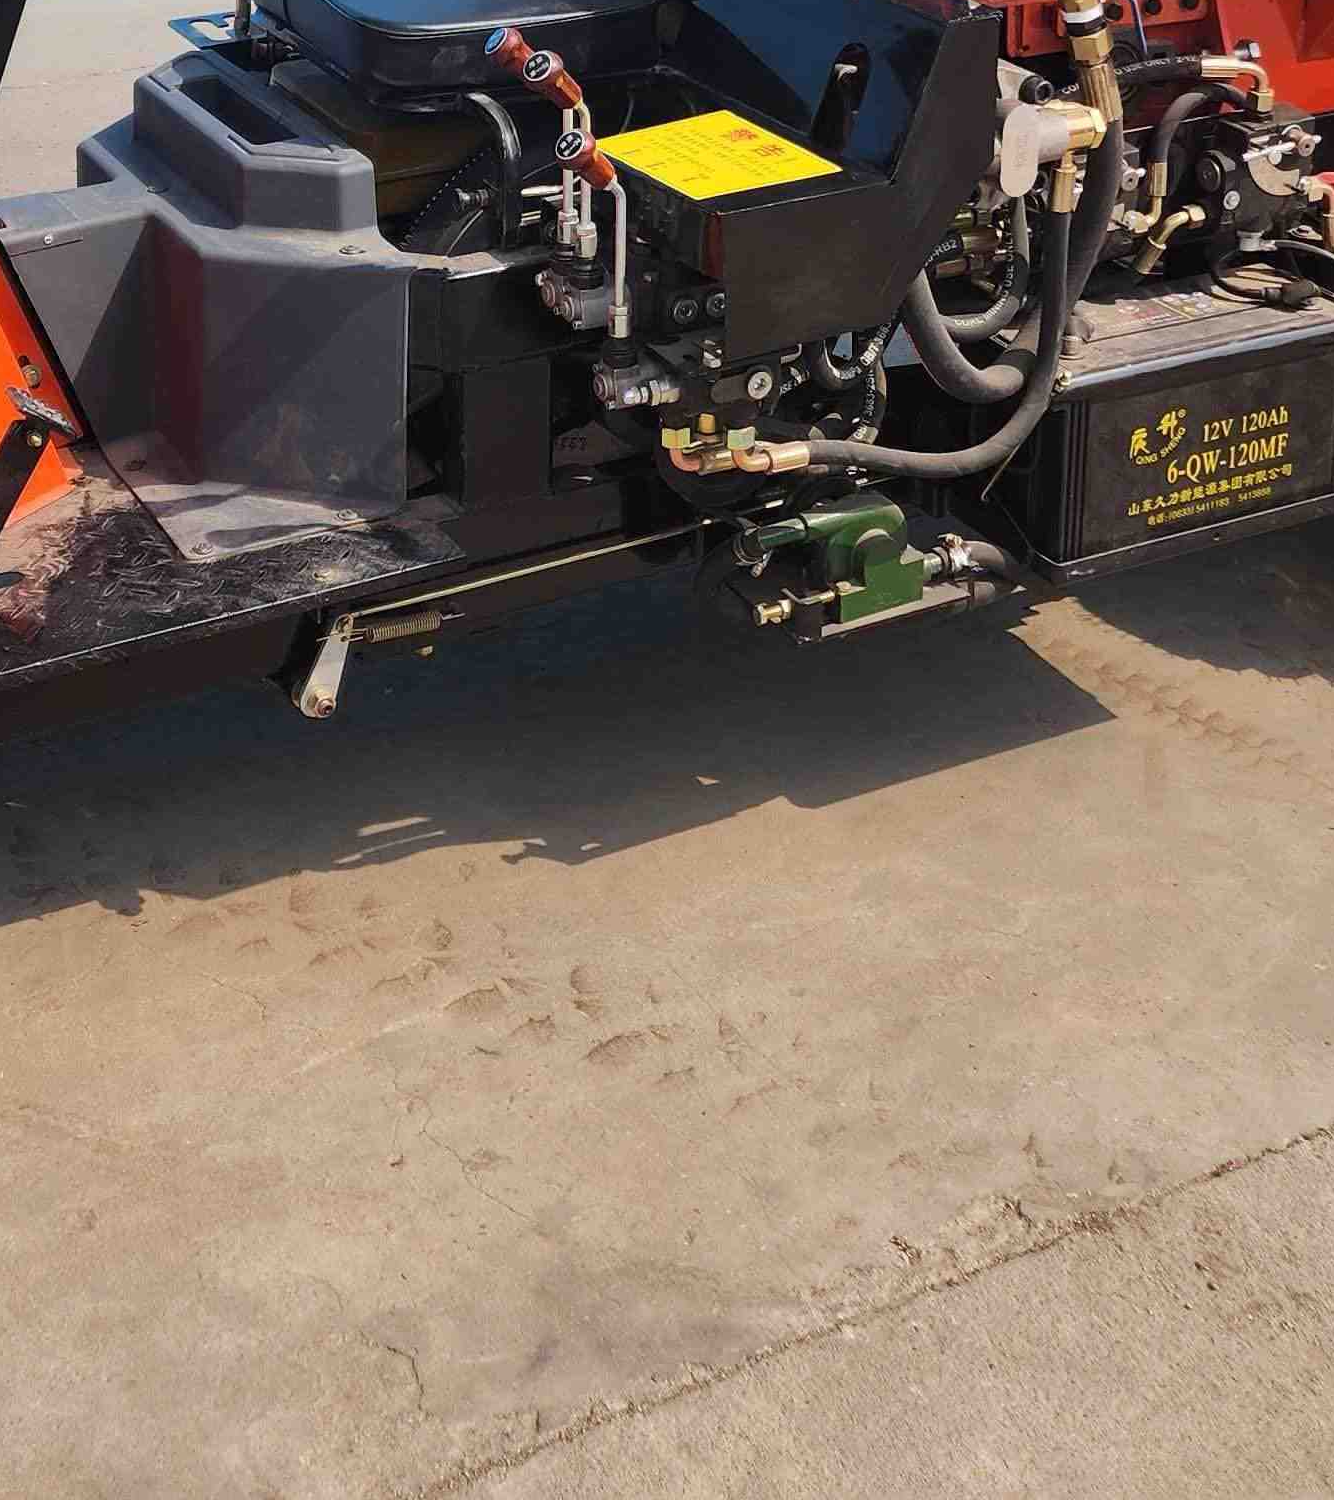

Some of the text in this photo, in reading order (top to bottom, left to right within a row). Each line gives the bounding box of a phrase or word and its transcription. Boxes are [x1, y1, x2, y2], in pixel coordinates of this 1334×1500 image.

[1203, 406, 1289, 443] 12V 120Ah
[1167, 432, 1290, 486] 6-QW-120MF
